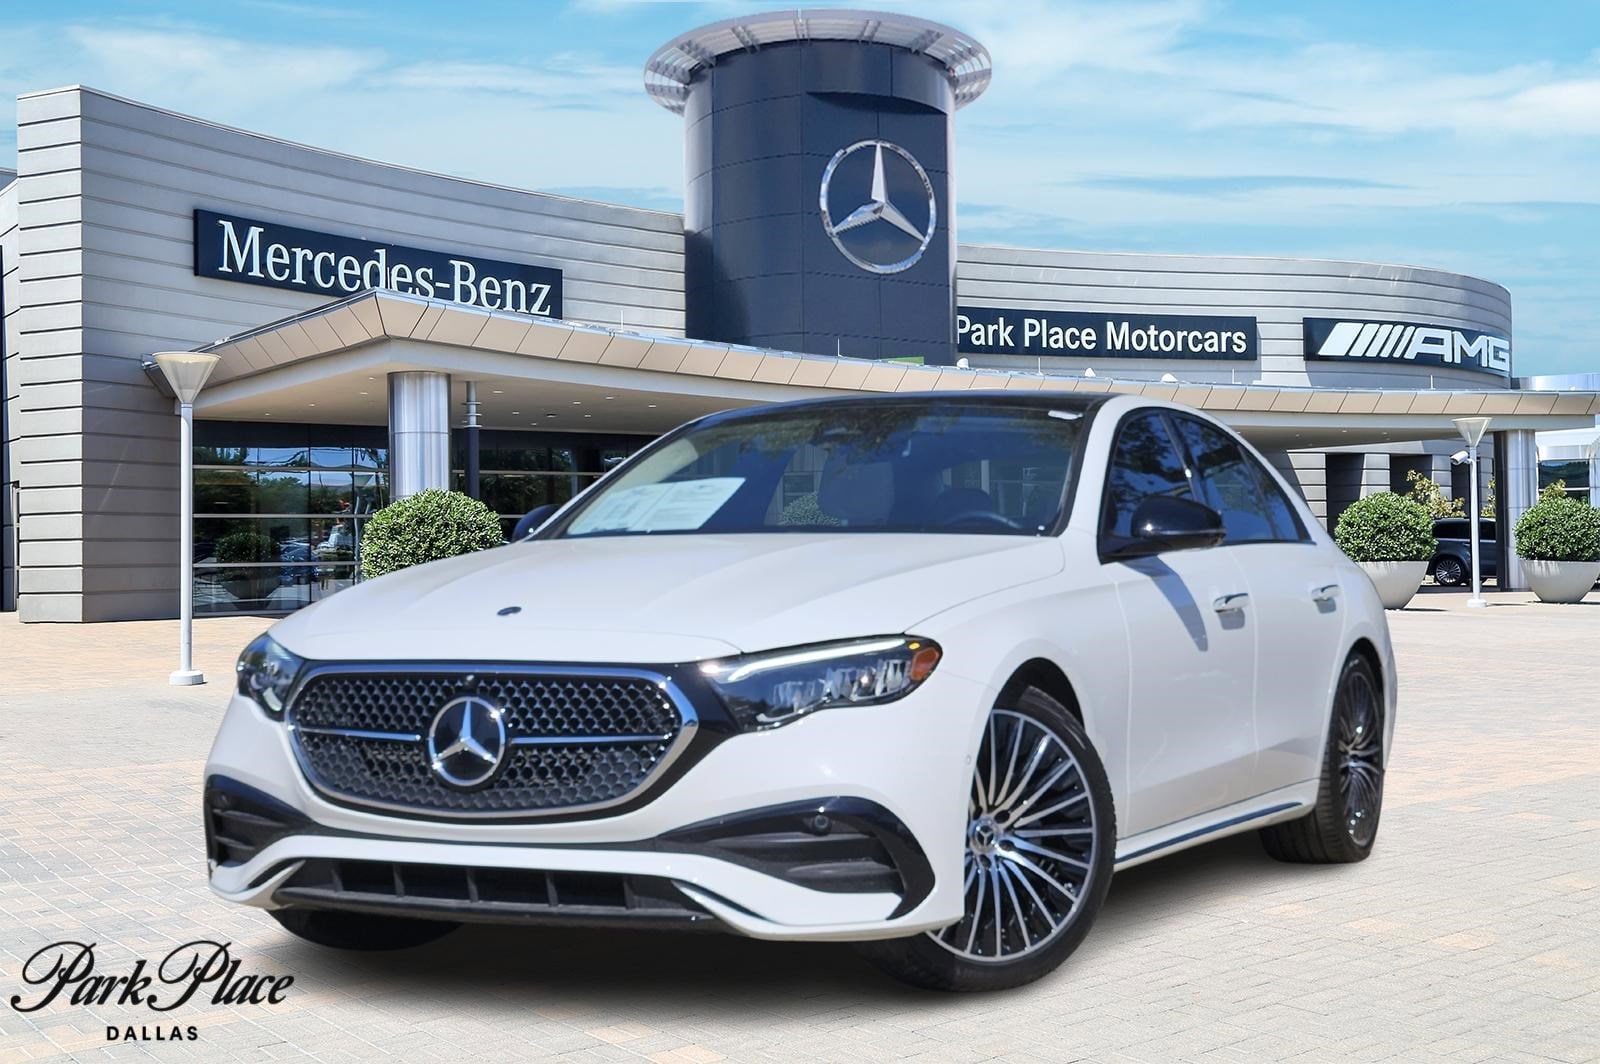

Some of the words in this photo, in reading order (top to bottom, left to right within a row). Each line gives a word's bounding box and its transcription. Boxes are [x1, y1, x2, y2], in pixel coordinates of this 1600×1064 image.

[217, 219, 552, 316] Mercedes-Benz
[957, 315, 1015, 348] Park
[1023, 318, 1097, 350] Place
[1106, 321, 1248, 353] Motorcars
[1403, 326, 1510, 373] AMG
